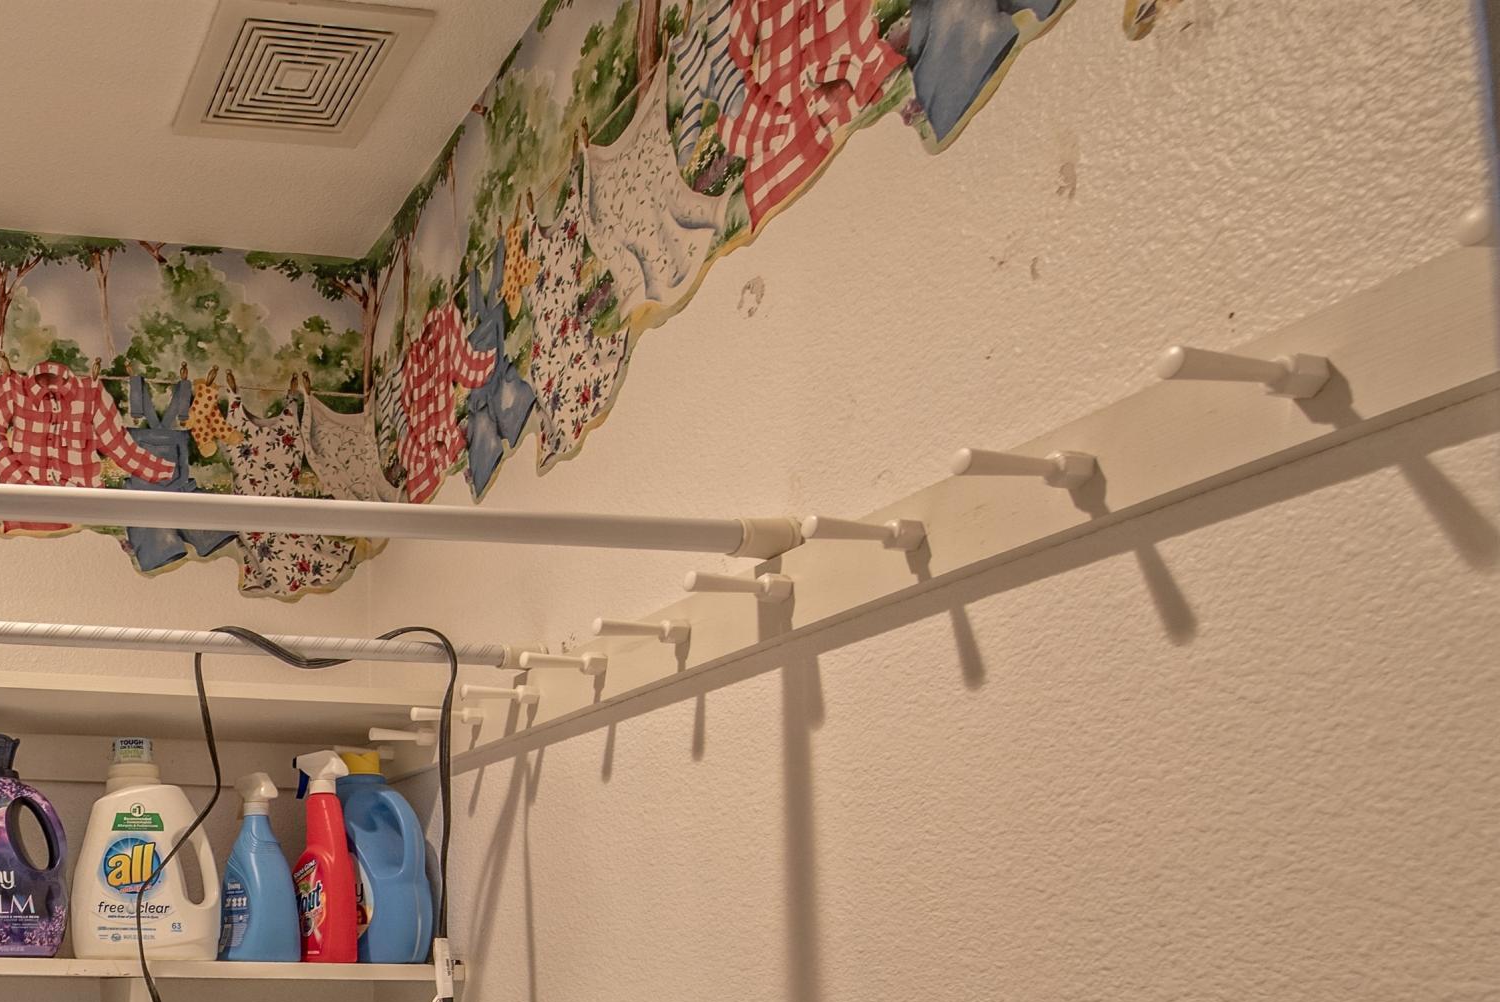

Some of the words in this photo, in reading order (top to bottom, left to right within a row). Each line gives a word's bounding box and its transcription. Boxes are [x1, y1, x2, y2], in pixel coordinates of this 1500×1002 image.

[106, 841, 157, 888] all
[98, 901, 124, 913] free
[172, 922, 182, 930] 63
